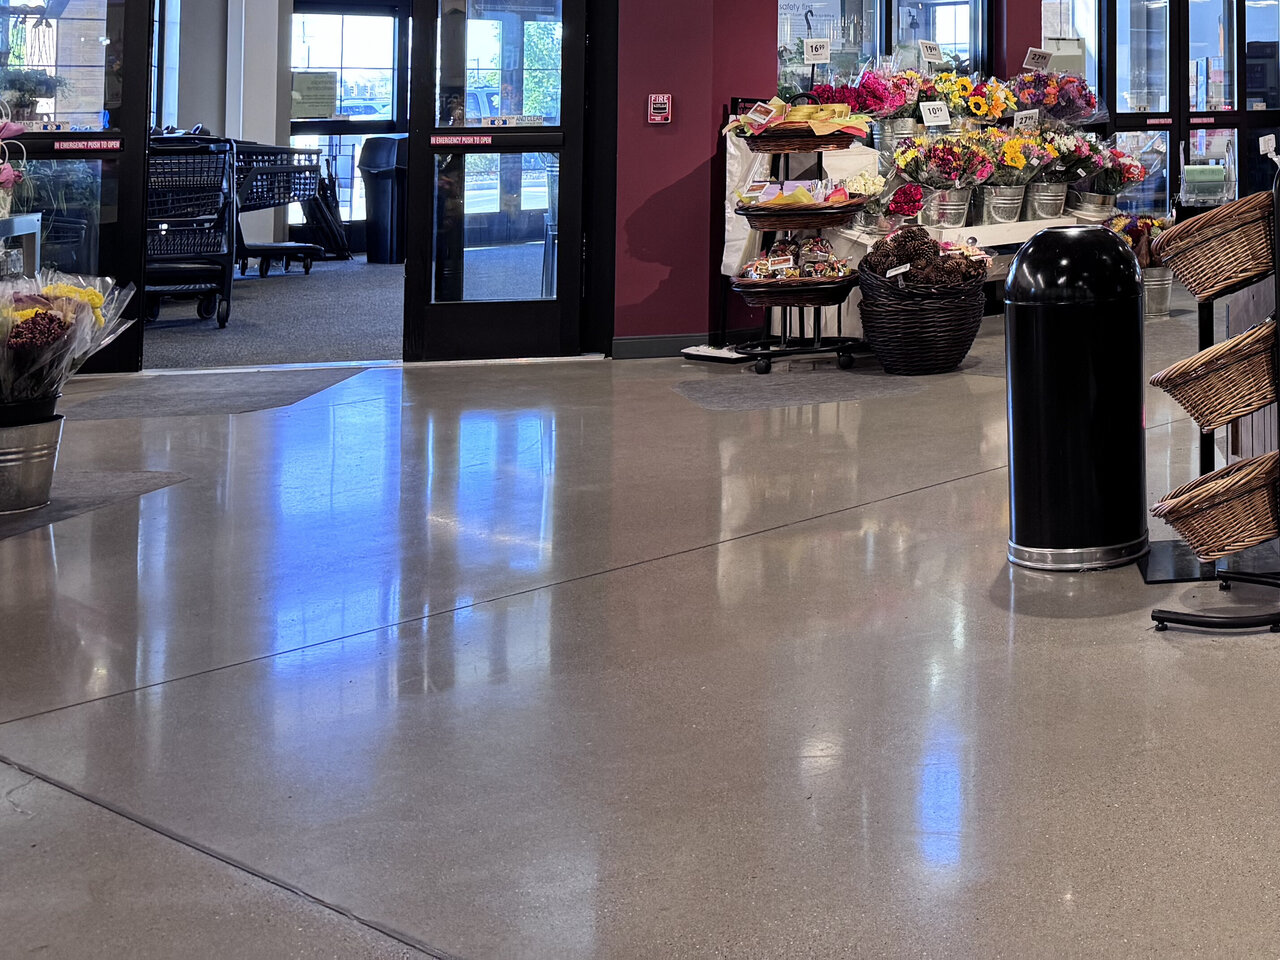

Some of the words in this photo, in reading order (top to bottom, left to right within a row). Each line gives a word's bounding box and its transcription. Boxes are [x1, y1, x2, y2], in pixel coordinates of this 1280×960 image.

[779, 3, 800, 12] safety
[435, 136, 461, 144] EMERGENCY
[461, 136, 474, 144] PUSH
[474, 136, 480, 144] TO
[480, 136, 492, 144] OPEN
[60, 141, 87, 149] EMERGENCY
[88, 141, 100, 149] PUSH
